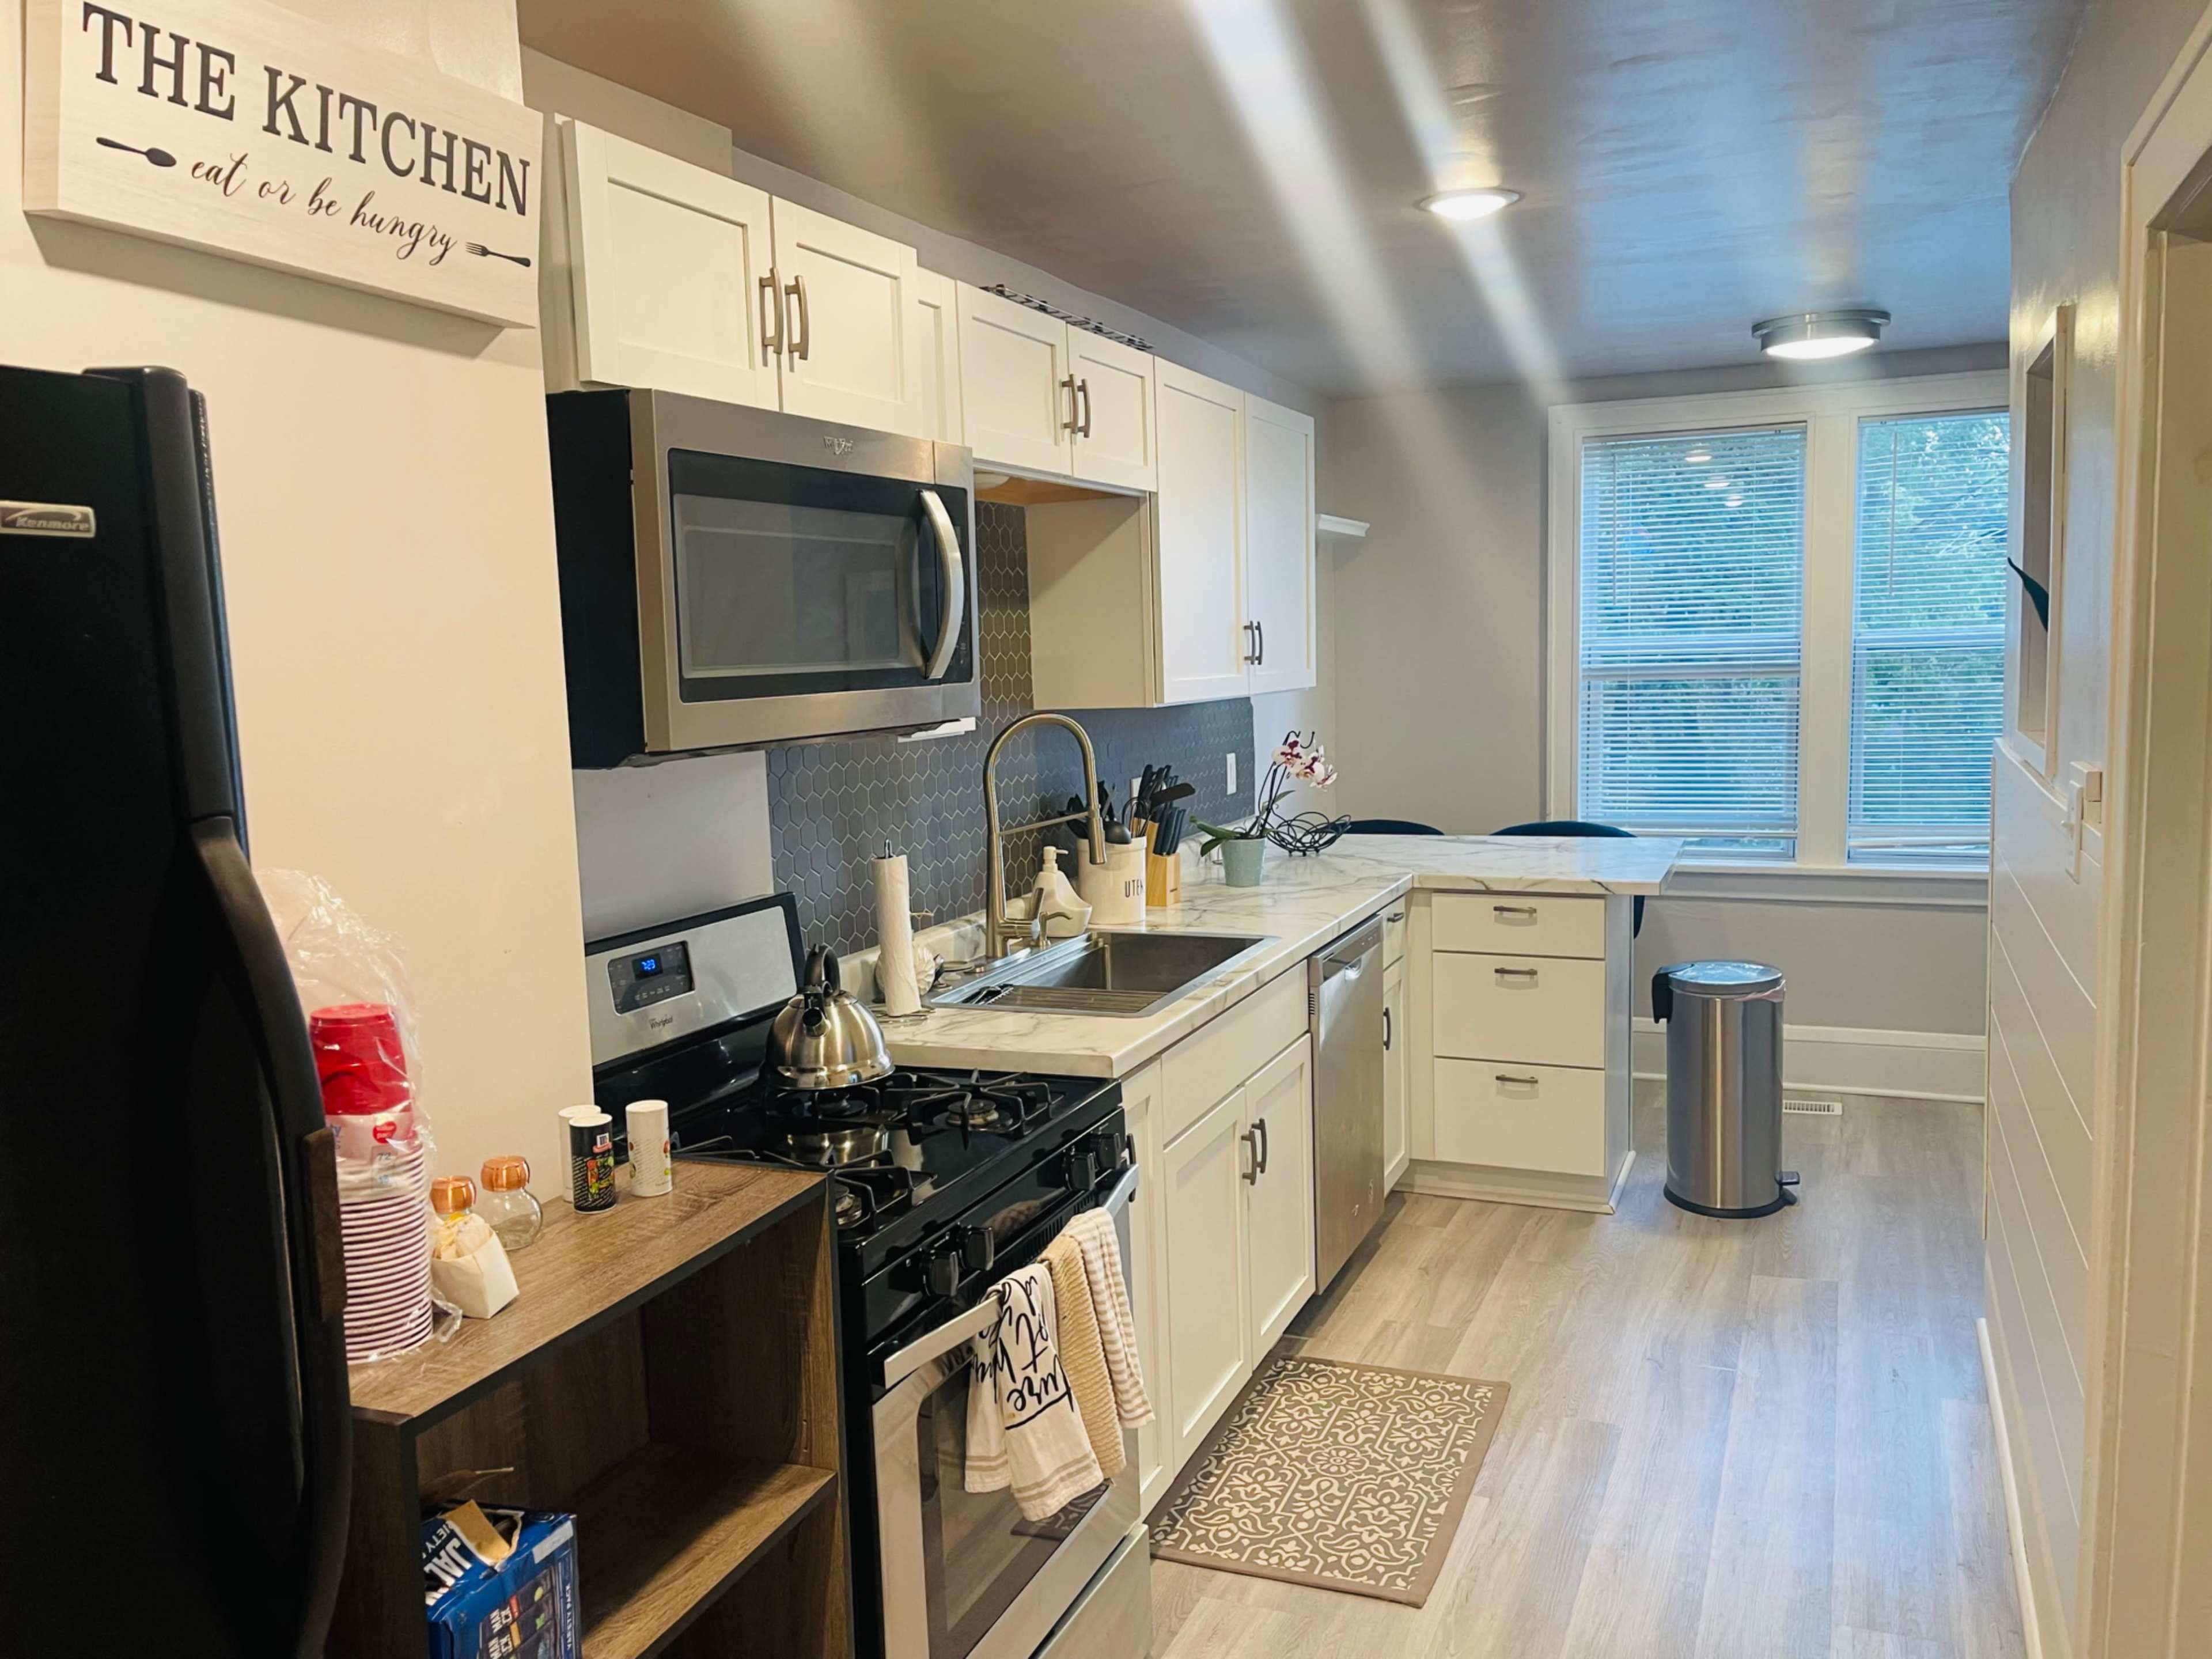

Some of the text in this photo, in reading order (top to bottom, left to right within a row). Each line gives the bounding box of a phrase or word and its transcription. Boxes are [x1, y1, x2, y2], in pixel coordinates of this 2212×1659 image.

[82, 1, 531, 217] THE KITCHEN
[191, 152, 458, 266] eat or be hungry
[15, 516, 90, 531] Kenmore
